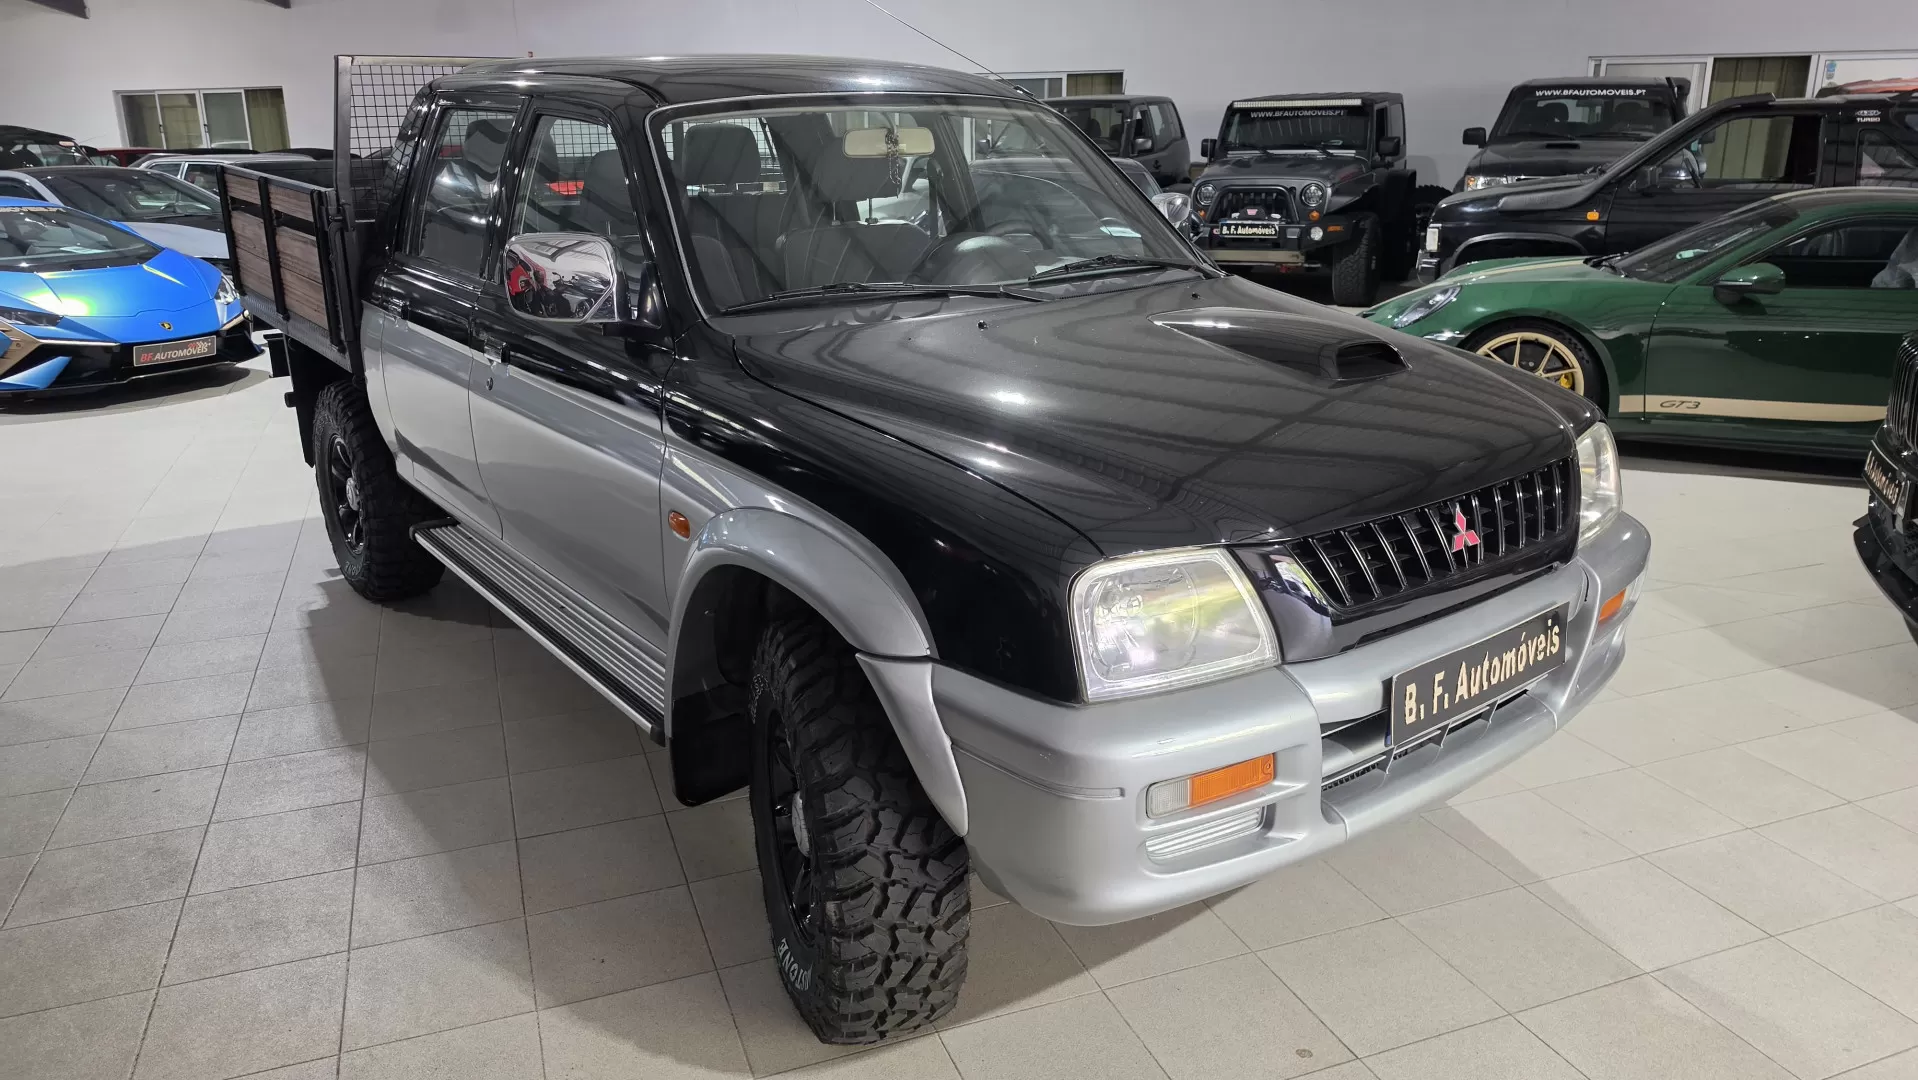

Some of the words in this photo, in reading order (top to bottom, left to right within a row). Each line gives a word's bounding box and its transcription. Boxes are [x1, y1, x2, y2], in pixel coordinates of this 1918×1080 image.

[1536, 89, 1647, 97] WWW.BFAUTOMOVEIS.PT
[1237, 224, 1276, 235] Automóveis
[1660, 399, 1701, 409] GT3
[1405, 682, 1425, 725] B.
[1432, 670, 1449, 714] F.
[1455, 619, 1561, 704] Automóveis
